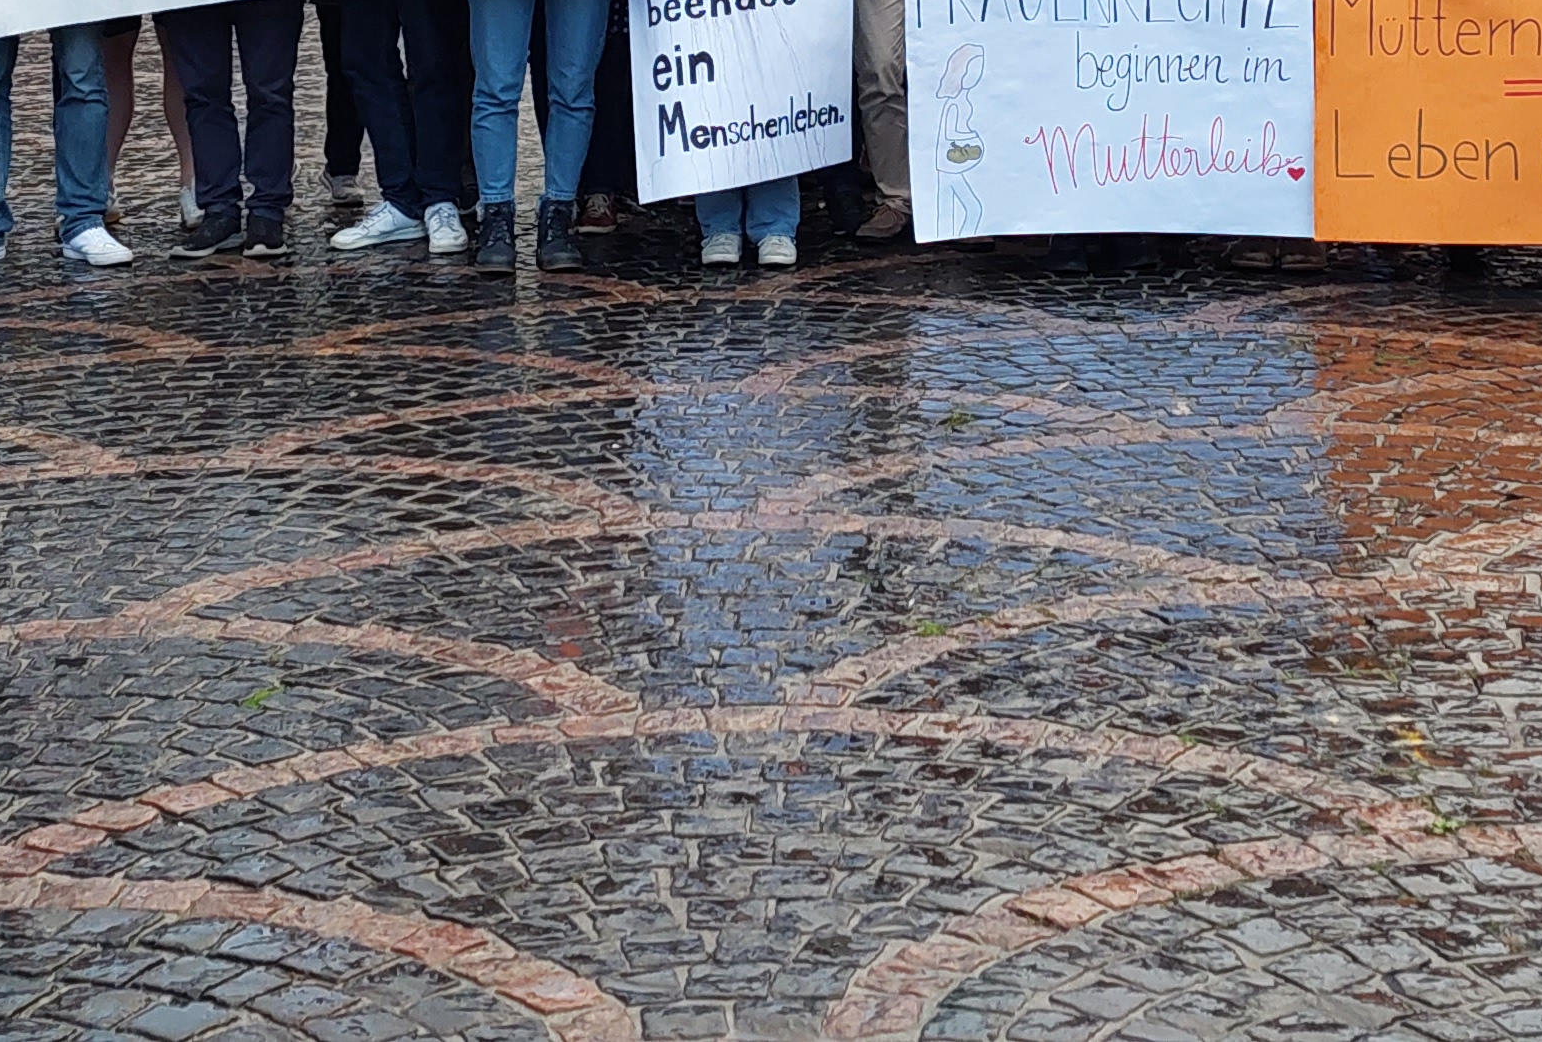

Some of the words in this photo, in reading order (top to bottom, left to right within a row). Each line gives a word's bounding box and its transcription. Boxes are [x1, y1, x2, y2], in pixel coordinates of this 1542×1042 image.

[652, 44, 715, 91] ein
[1075, 30, 1230, 111] beginnen
[1243, 46, 1291, 83] im
[659, 91, 845, 157] Menschenleben.
[1022, 113, 1303, 195] Mutterleib
[1333, 108, 1519, 181] Leben
